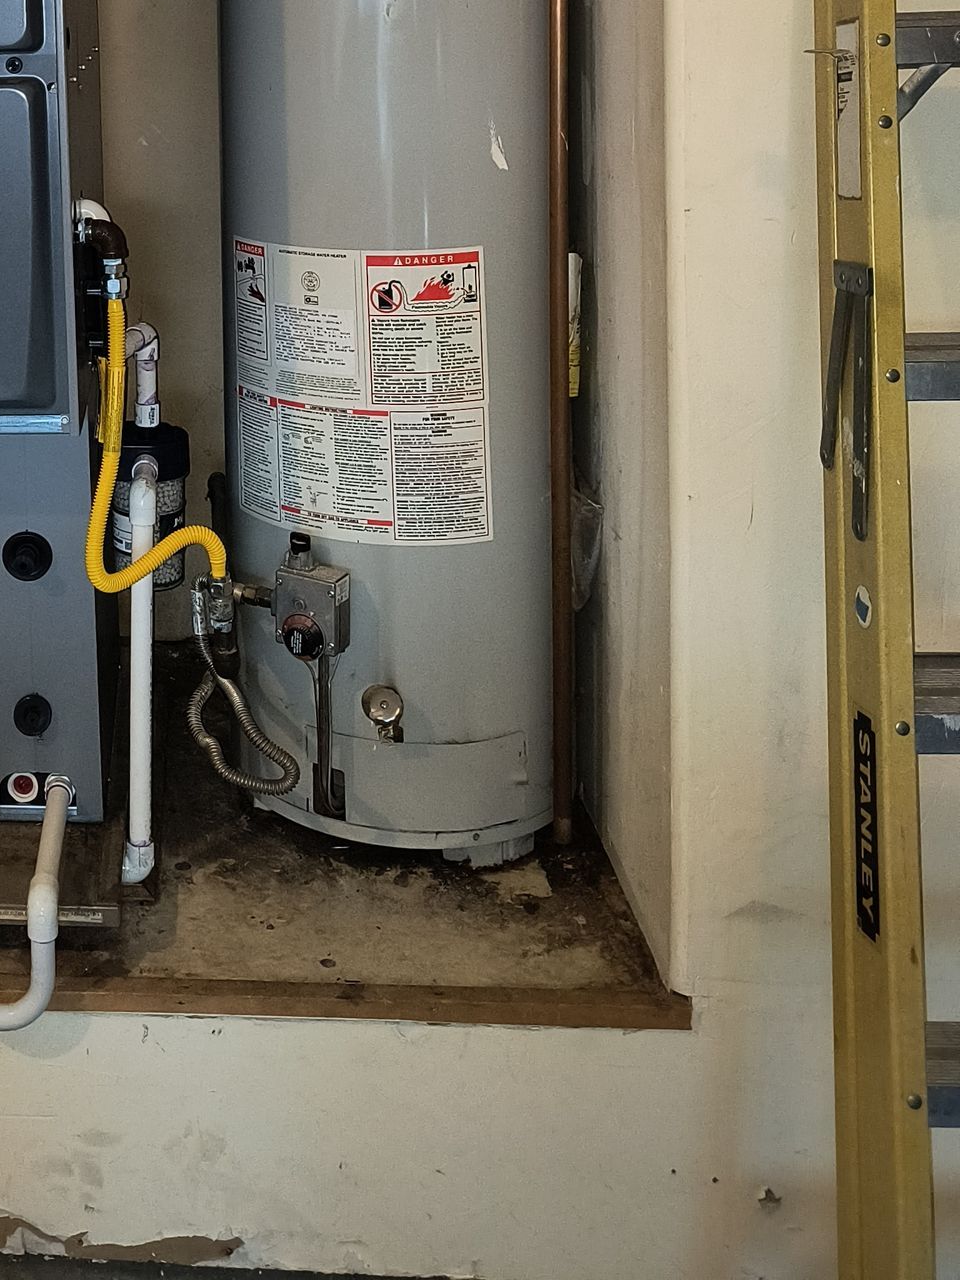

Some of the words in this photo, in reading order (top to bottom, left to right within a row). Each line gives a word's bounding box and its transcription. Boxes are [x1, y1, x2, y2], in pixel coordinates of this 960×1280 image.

[240, 243, 263, 254] DANGER
[404, 255, 454, 265] DANGER
[858, 729, 874, 924] STANLEY
